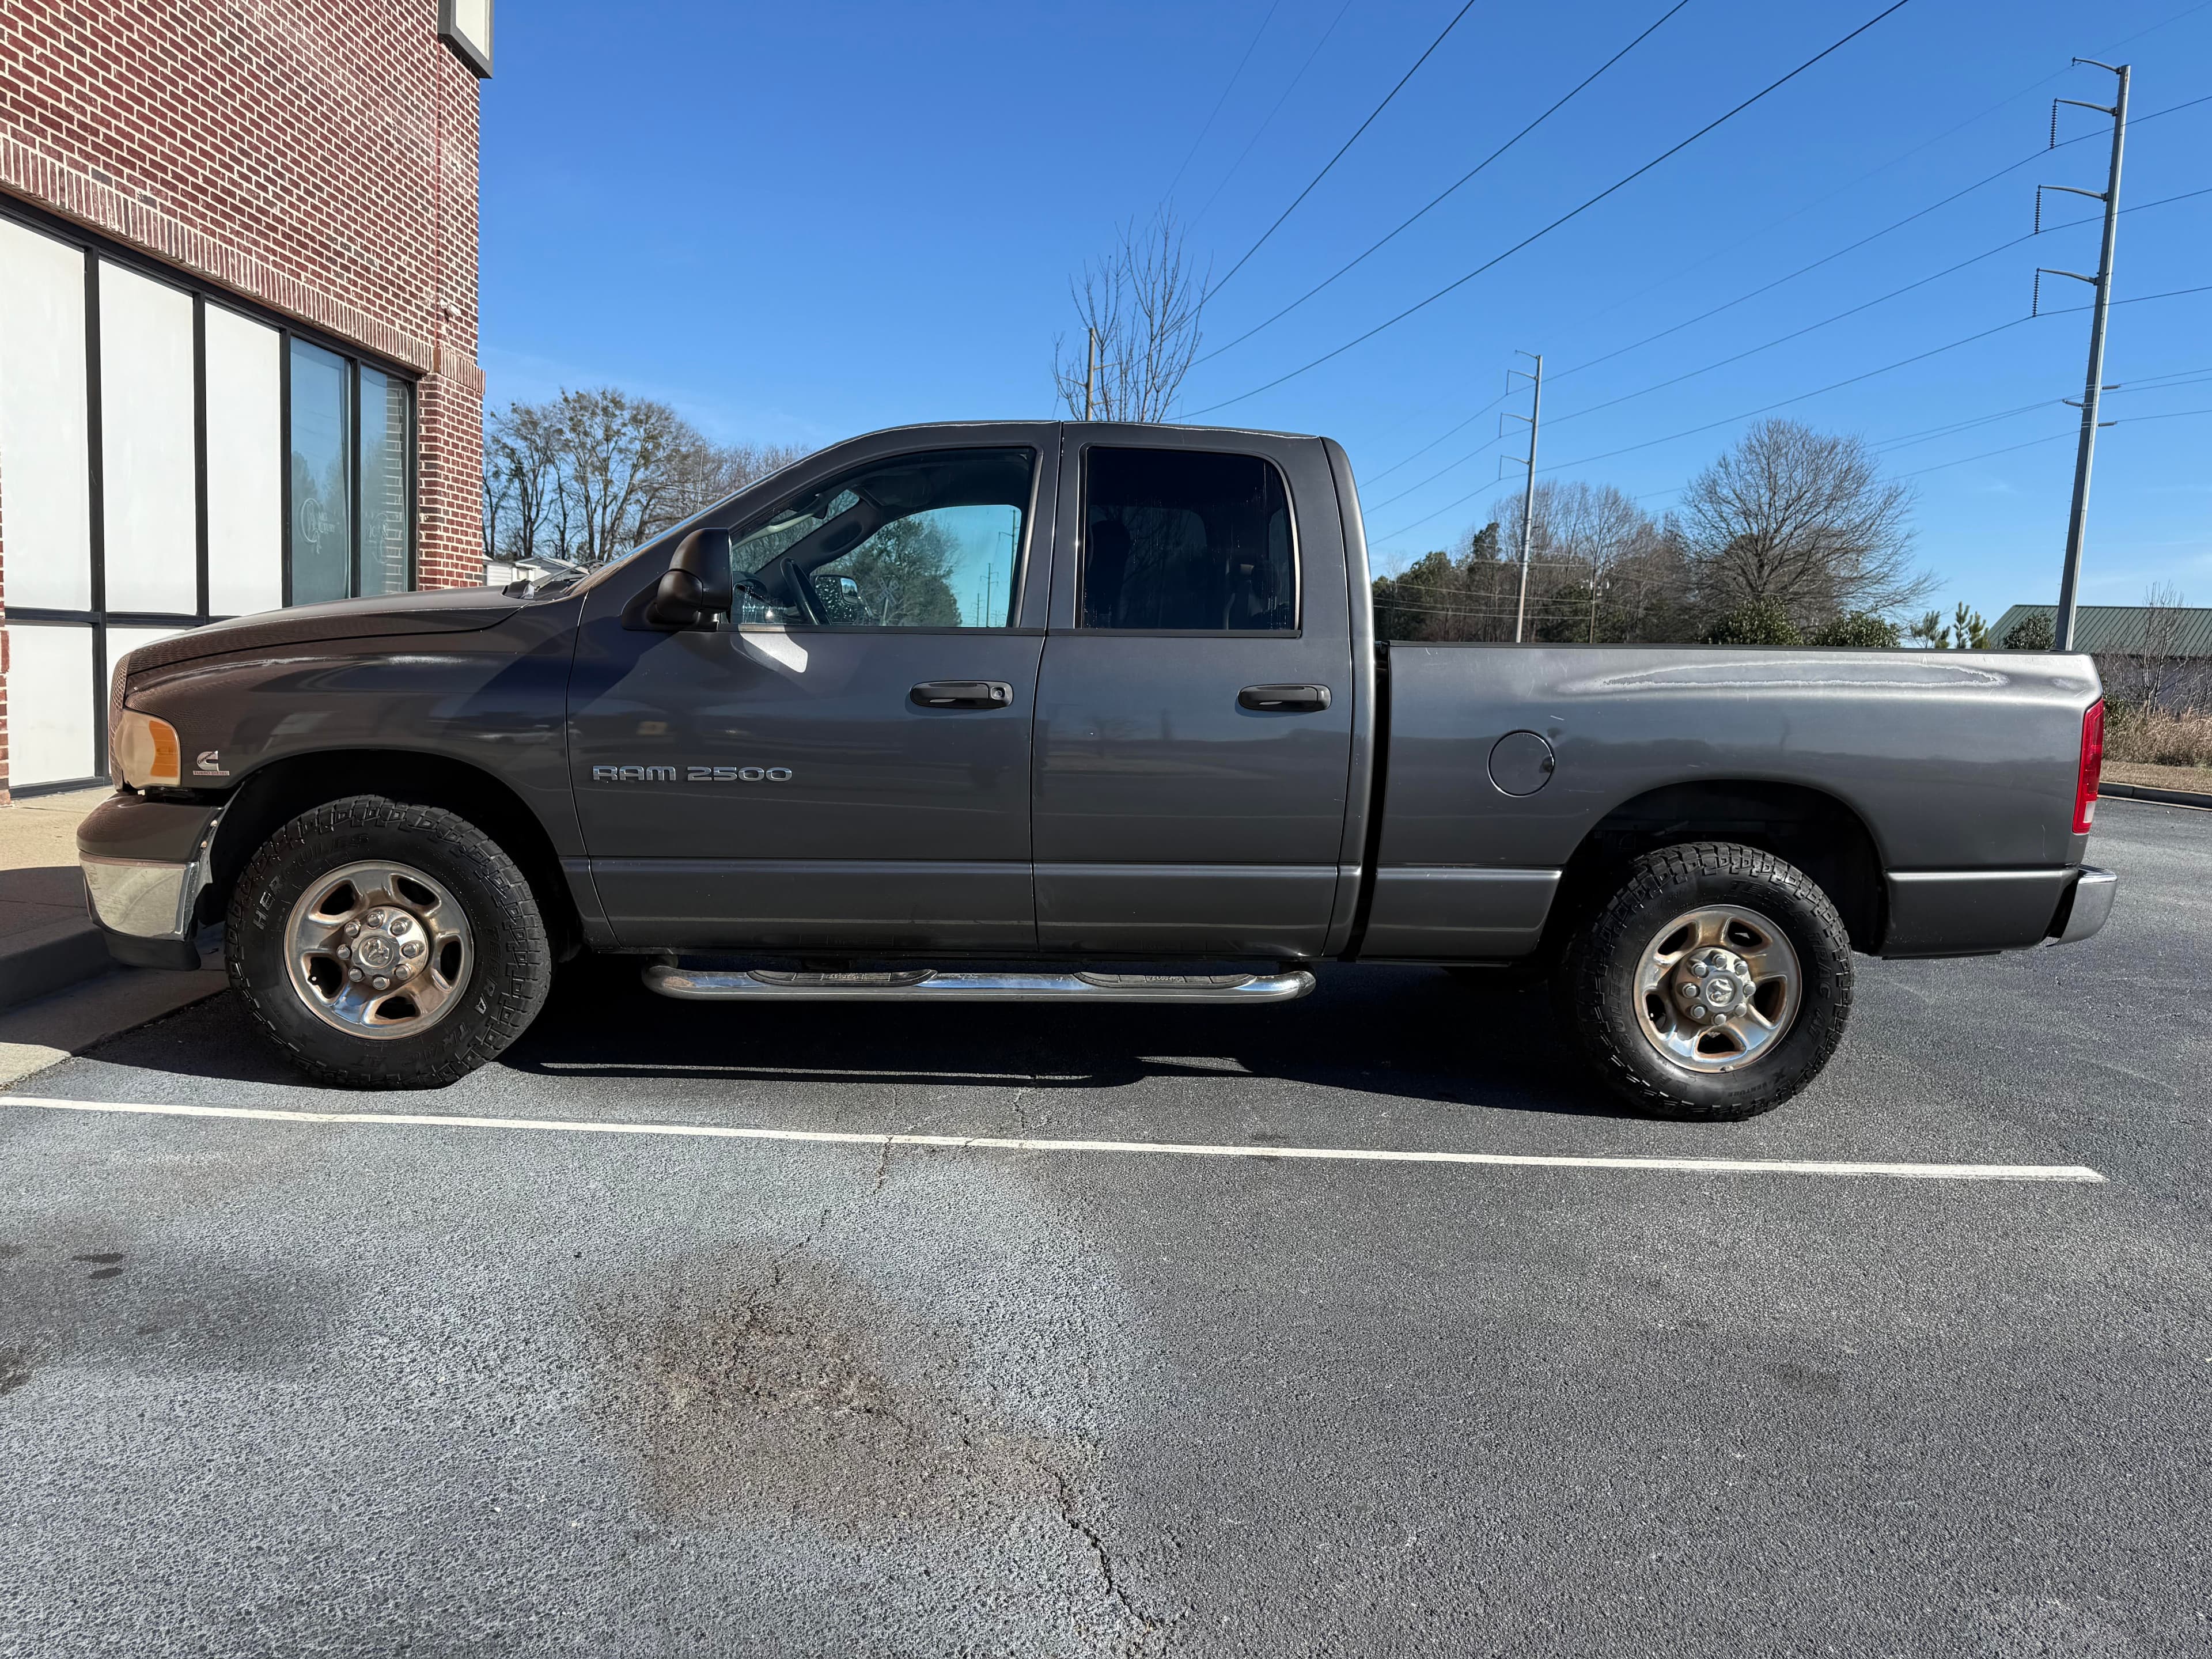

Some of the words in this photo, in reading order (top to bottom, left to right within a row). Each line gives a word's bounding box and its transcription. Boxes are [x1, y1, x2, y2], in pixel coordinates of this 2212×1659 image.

[592, 765, 677, 782] RAM
[687, 766, 793, 782] 2500
[474, 925, 503, 1015] TERRA
[1609, 963, 1673, 1088] HERCULES
